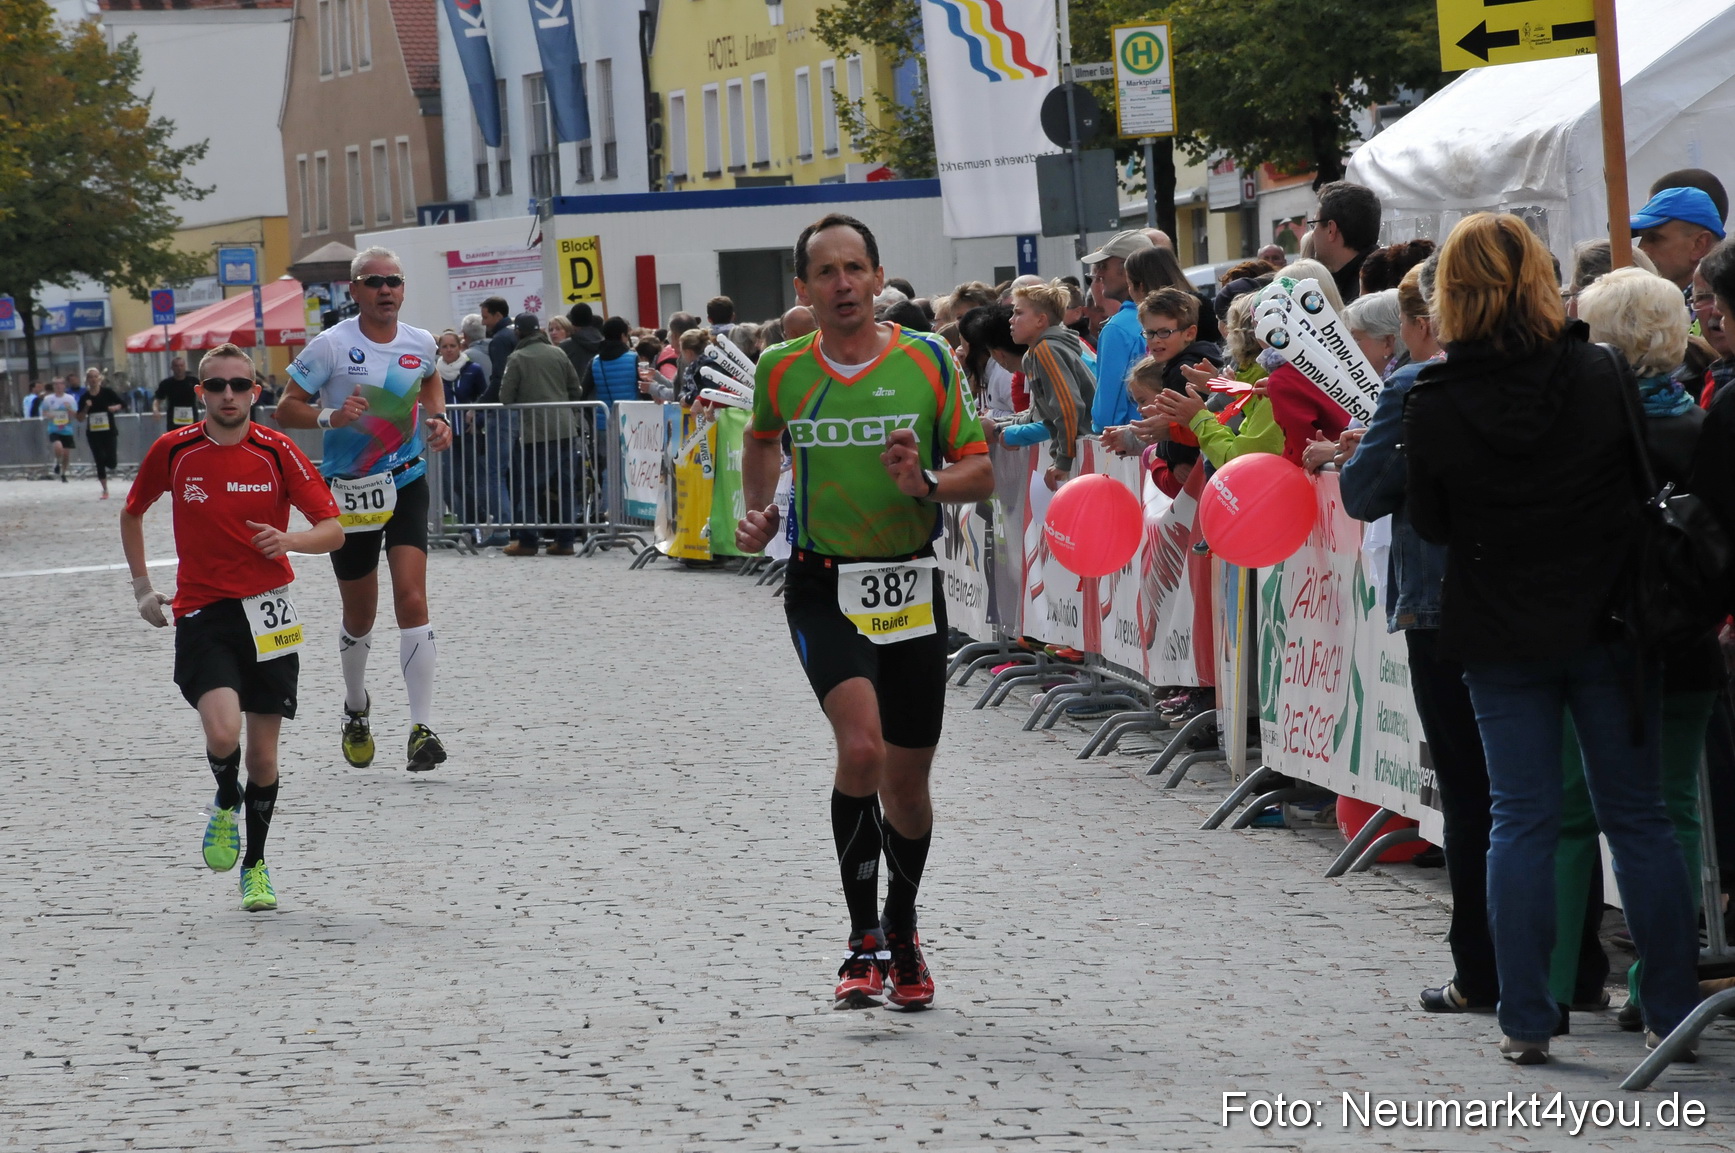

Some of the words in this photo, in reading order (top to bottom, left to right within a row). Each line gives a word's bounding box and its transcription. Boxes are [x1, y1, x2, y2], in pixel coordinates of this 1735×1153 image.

[707, 35, 738, 71] HOTEL
[1075, 67, 1098, 78] Ulmer
[1126, 79, 1162, 87] Marktplatz
[562, 240, 597, 253] Block
[570, 257, 593, 290] D
[469, 277, 516, 290] DAHMIT
[154, 314, 174, 322] TAXI
[720, 359, 740, 379] BMW
[787, 413, 921, 447] BOCK
[227, 482, 272, 492] Marcel
[352, 480, 383, 490] Neumarkt
[344, 488, 385, 511] 510
[861, 569, 918, 608] 382
